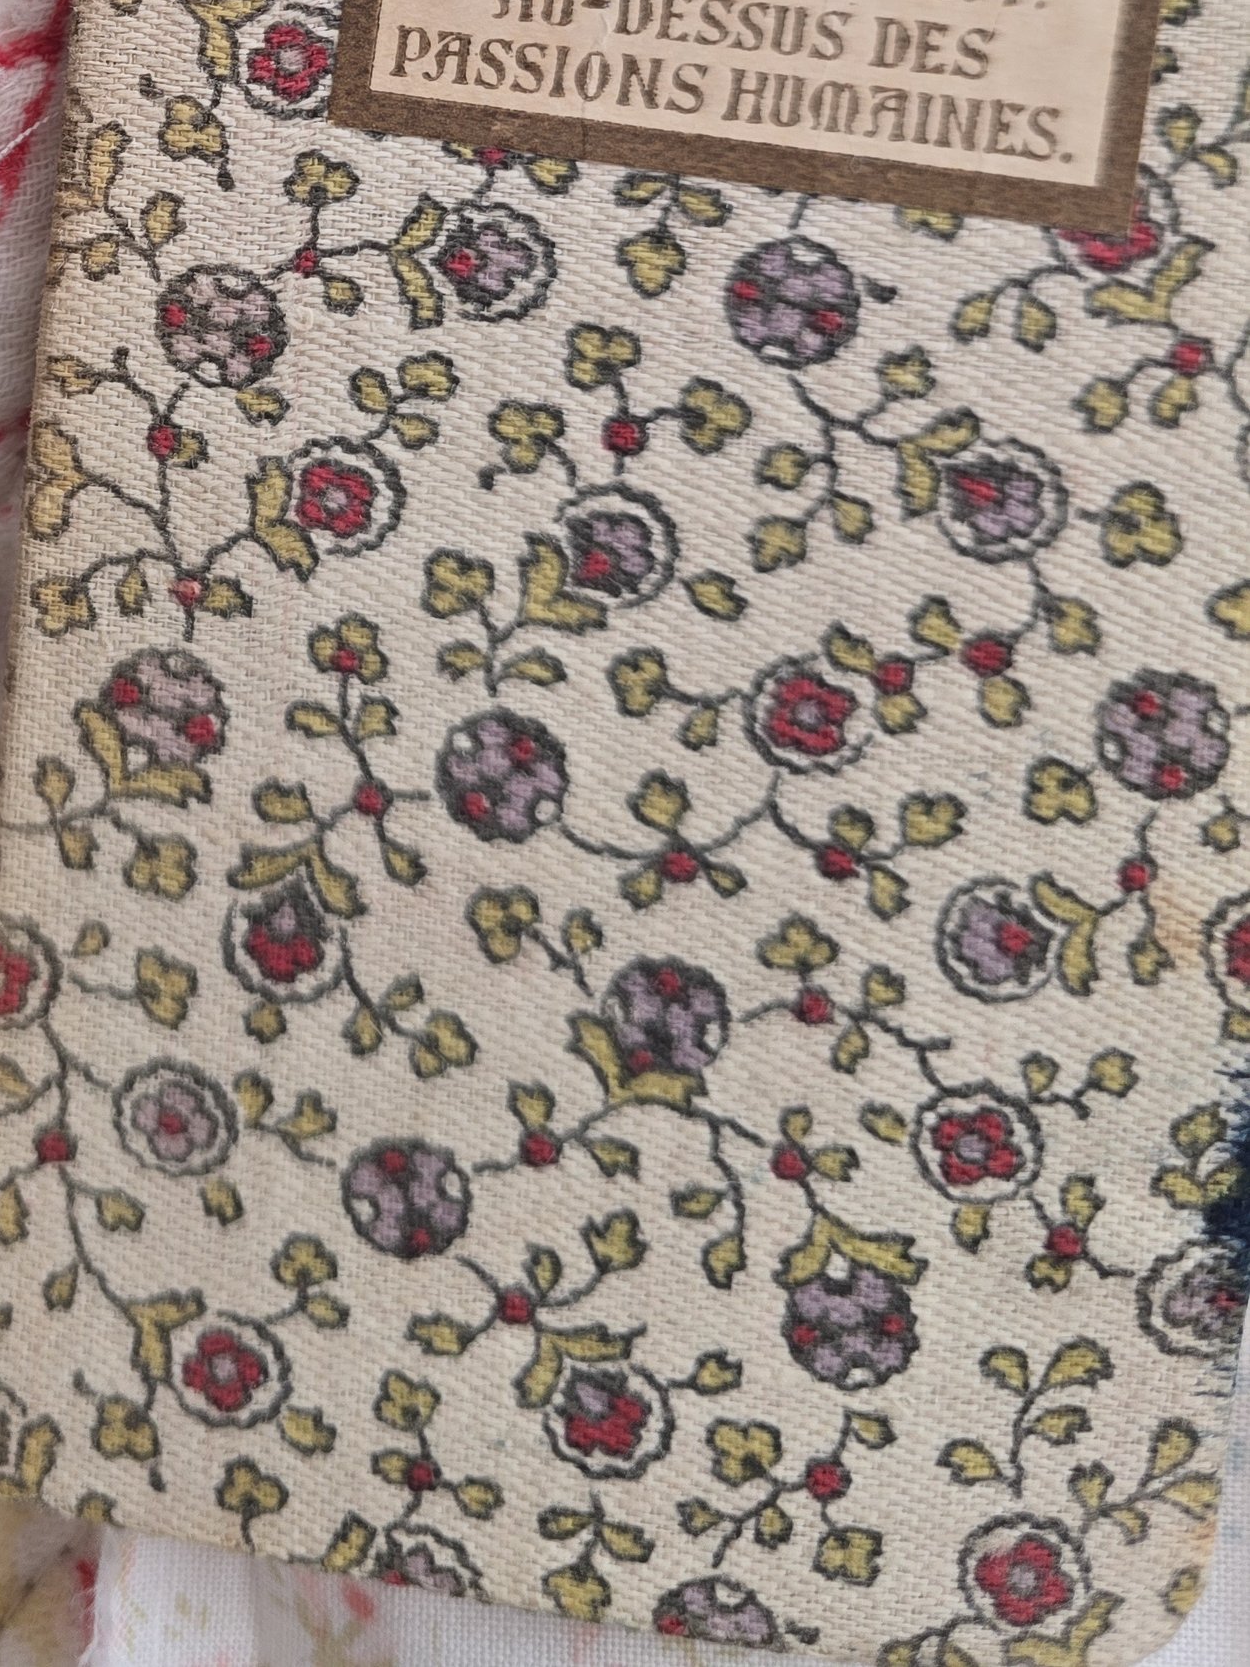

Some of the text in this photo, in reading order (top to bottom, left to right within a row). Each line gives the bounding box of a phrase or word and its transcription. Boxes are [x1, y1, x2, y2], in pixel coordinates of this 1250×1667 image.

[390, 25, 1074, 165] PASSIONS HUMAINES.
[869, 16, 996, 81] DES
